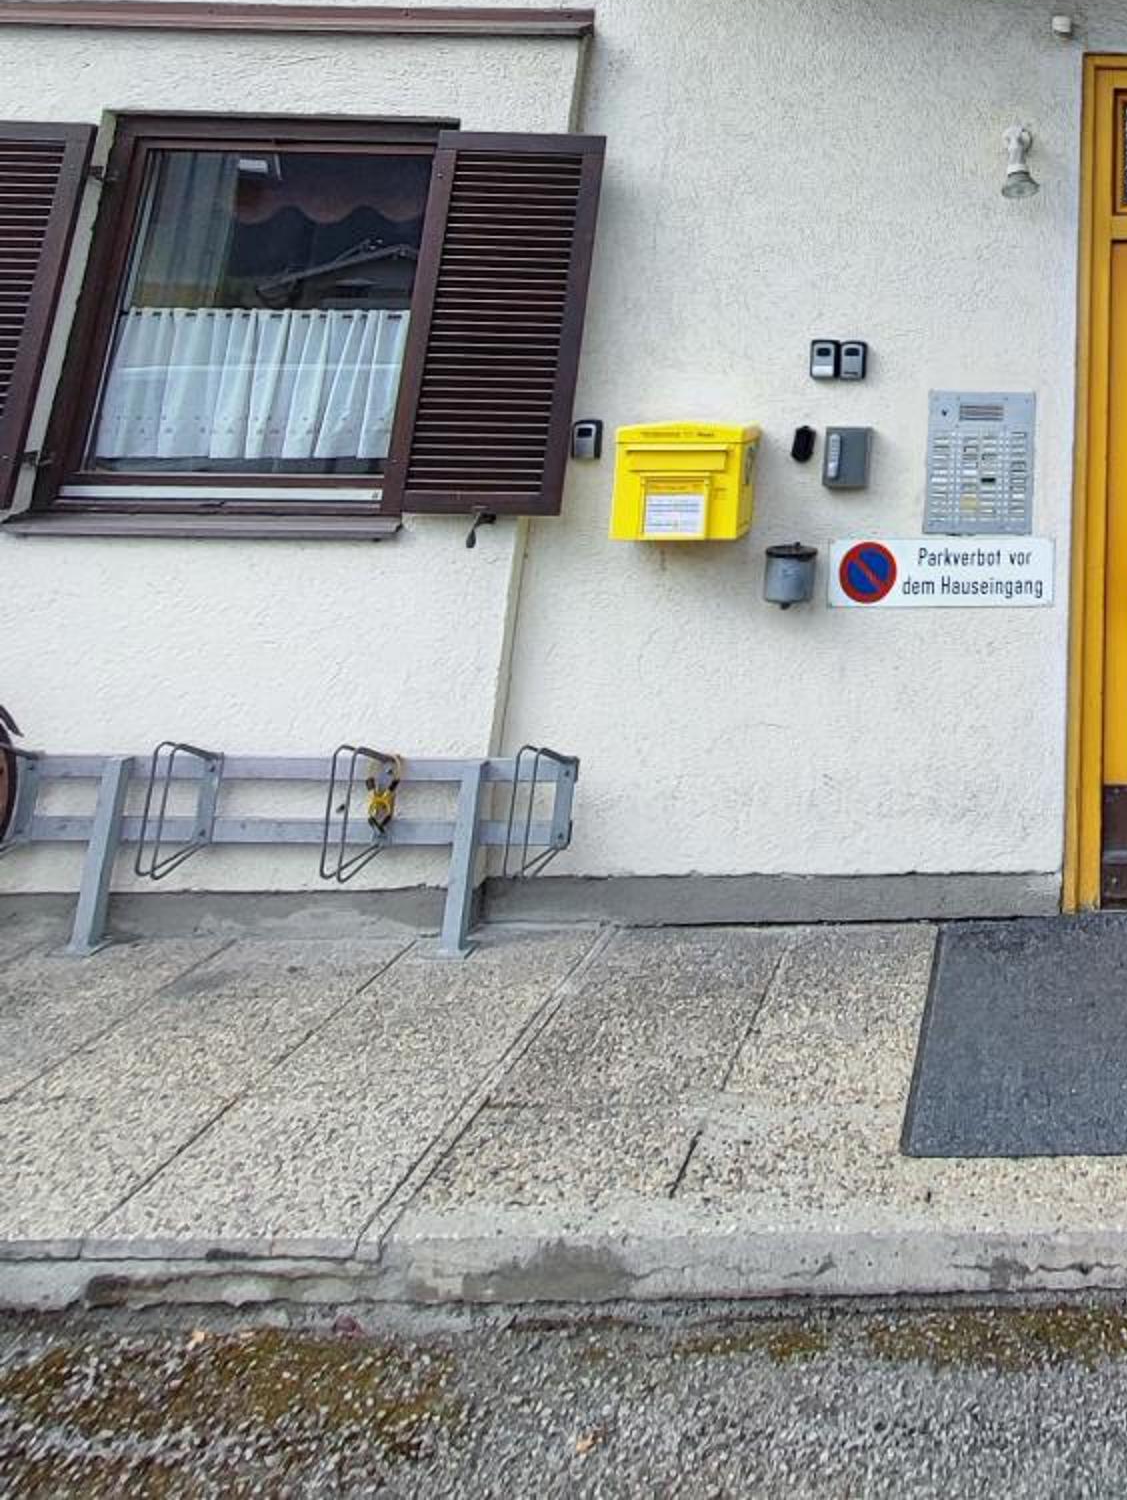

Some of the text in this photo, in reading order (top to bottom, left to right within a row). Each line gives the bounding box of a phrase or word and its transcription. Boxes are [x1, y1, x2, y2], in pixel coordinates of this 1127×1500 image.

[918, 548, 1032, 566] Parkverbot vor
[902, 576, 1043, 599] dem Hauseingang
